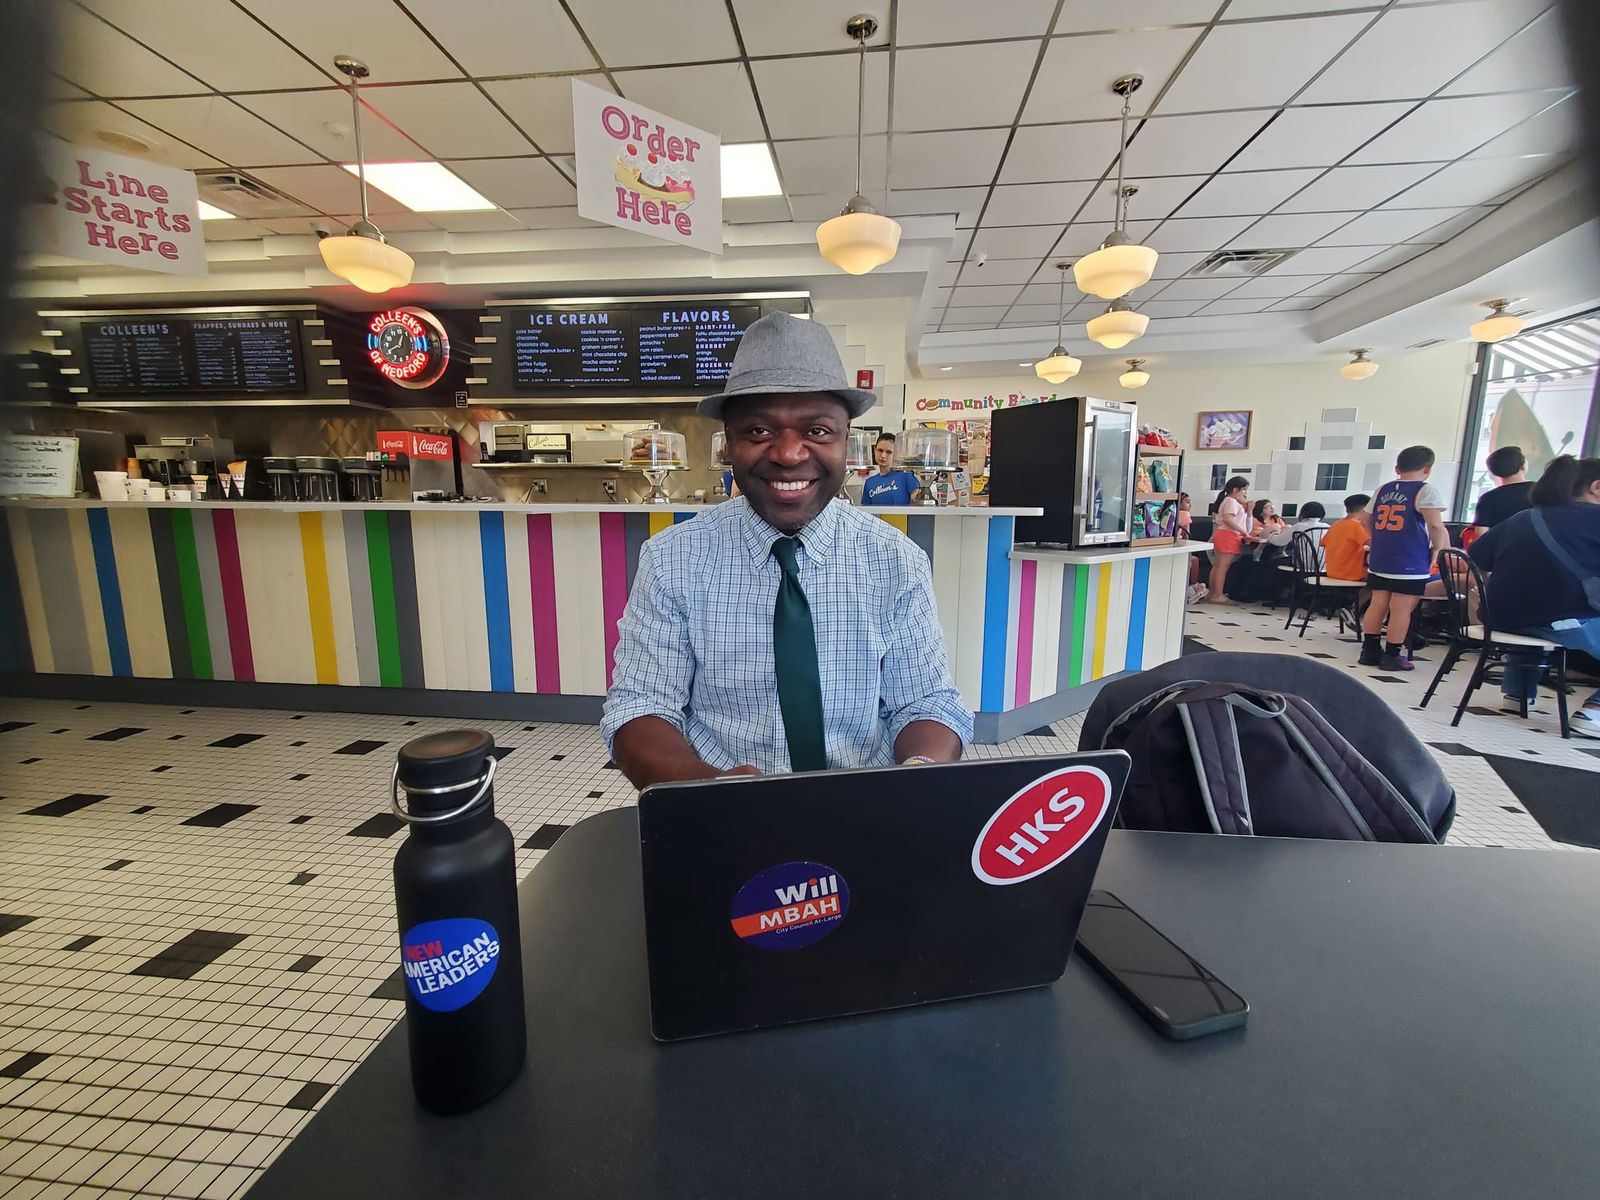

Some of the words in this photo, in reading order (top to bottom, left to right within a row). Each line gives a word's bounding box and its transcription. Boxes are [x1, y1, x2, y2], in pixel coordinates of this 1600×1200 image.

[601, 105, 701, 163] Order
[76, 160, 169, 204] Line
[63, 186, 191, 233] Starts
[615, 186, 693, 236] Here
[84, 221, 180, 260] Here
[100, 324, 169, 336] COLLEEN'S
[370, 311, 423, 334] COLLEEN'S
[530, 314, 553, 325] ICE
[559, 313, 609, 325] CREAM
[662, 310, 730, 322] FLAVORS
[370, 350, 383, 364] OF
[381, 352, 426, 378] MEDFORD
[868, 480, 898, 498] Colleen's
[1375, 504, 1406, 531] 35
[995, 787, 1085, 867] HKS
[774, 874, 838, 906] Will
[760, 896, 837, 930] MBAH
[789, 920, 814, 931] Council
[404, 931, 491, 978] AMERICAN
[406, 940, 443, 961] NEW
[416, 940, 500, 994] LEADERS
